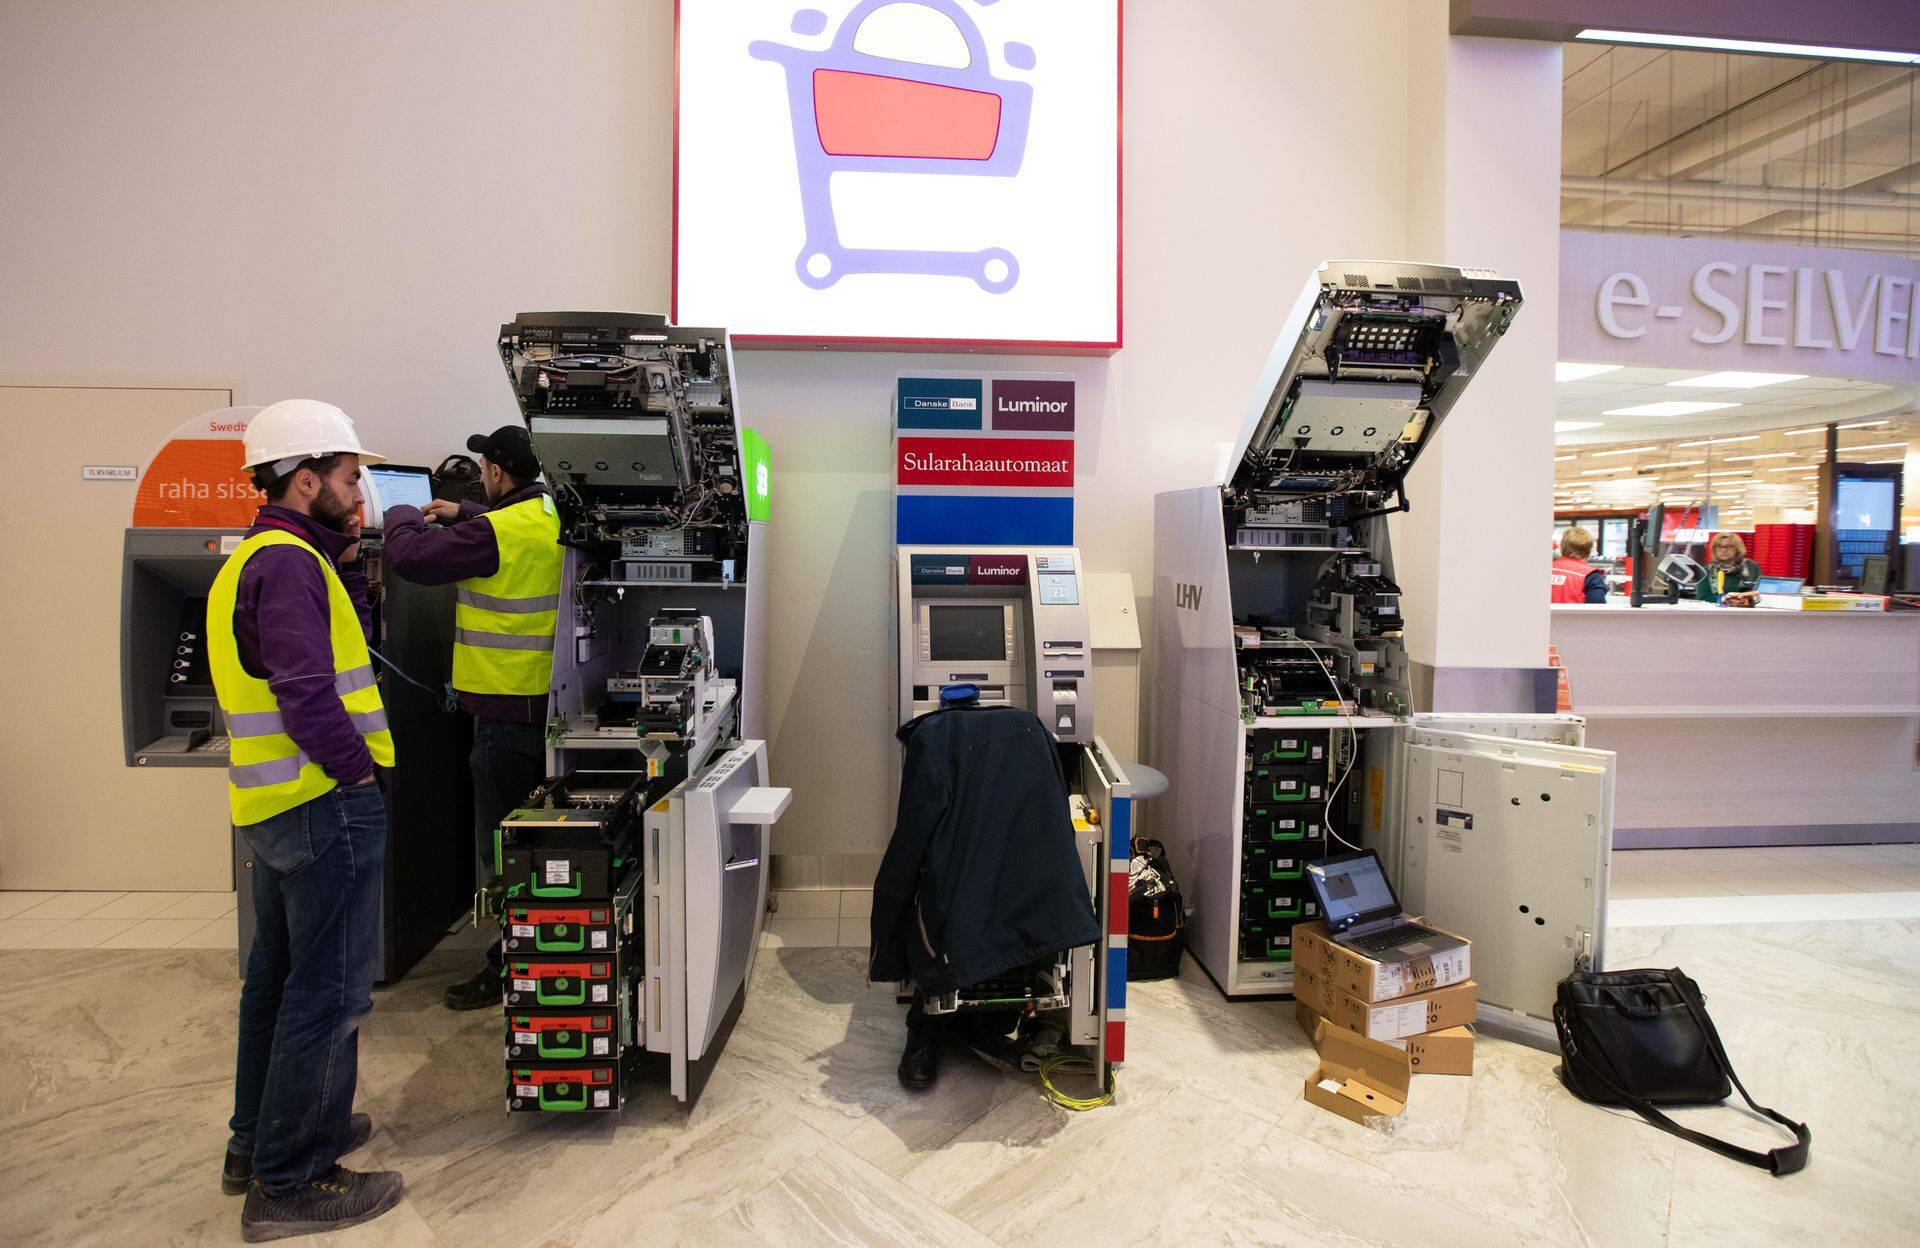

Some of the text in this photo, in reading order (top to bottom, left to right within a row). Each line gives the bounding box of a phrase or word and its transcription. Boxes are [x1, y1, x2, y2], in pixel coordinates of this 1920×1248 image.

[1597, 261, 1920, 358] e-SELVE
[914, 400, 948, 408] Danske
[998, 396, 1068, 413] Luminor
[903, 452, 1069, 473] Sularahaautomaat
[160, 478, 210, 499] raha
[978, 566, 1020, 576] Luminor
[1176, 583, 1203, 611] LHV
